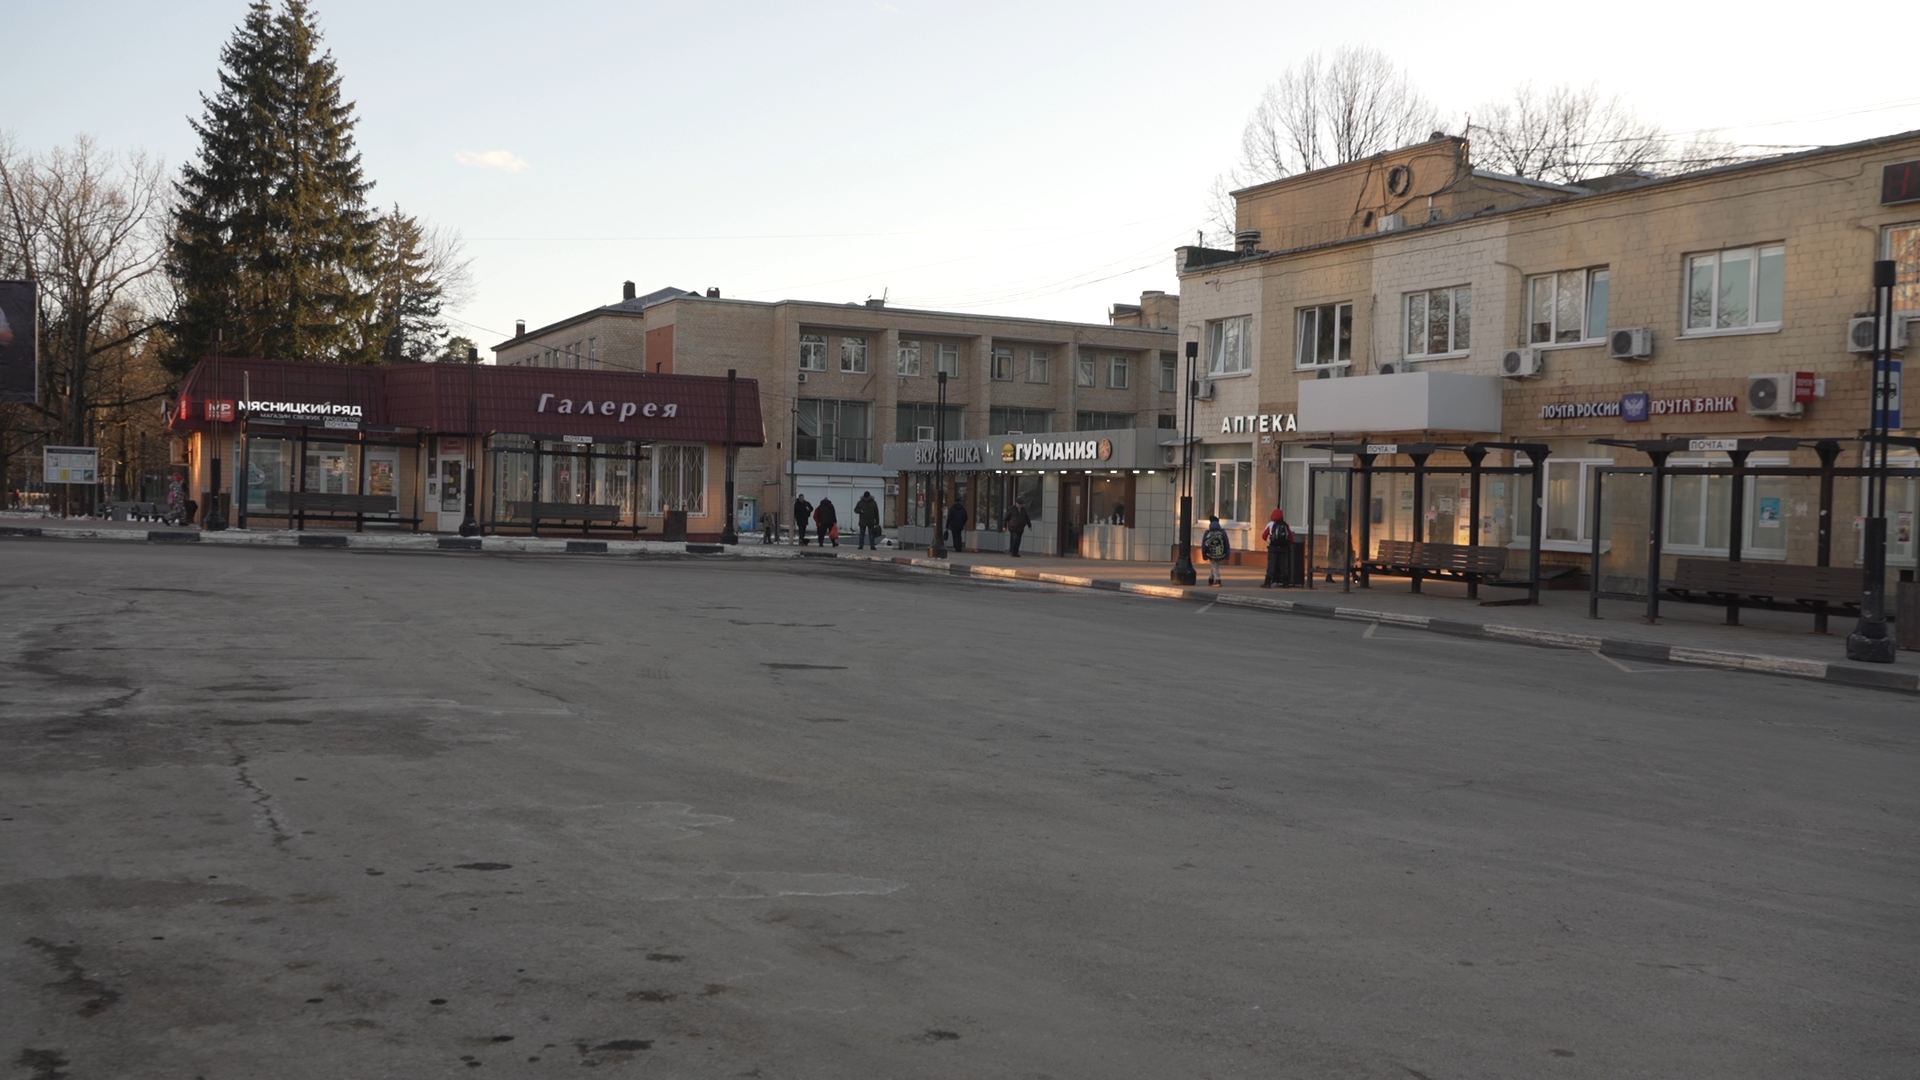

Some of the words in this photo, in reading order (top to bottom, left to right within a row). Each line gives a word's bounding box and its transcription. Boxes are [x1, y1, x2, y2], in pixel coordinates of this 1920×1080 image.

[238, 401, 331, 413] МЯСНИЦКИЙ
[332, 405, 362, 416] РЯД
[537, 393, 678, 422] Галерея
[1541, 405, 1575, 418] ПОЧТА
[1576, 402, 1620, 416] РОССИИ
[1651, 400, 1691, 414] ПОЧТА
[1692, 397, 1735, 412] БАНК
[1221, 413, 1297, 434] АПТЕКА
[1015, 441, 1097, 461] ГУРМАНИЯ
[1367, 445, 1389, 453] ПОЧТА
[1691, 440, 1723, 449] ПОЧТА
[915, 447, 981, 464] ВКУСНЯШКА
